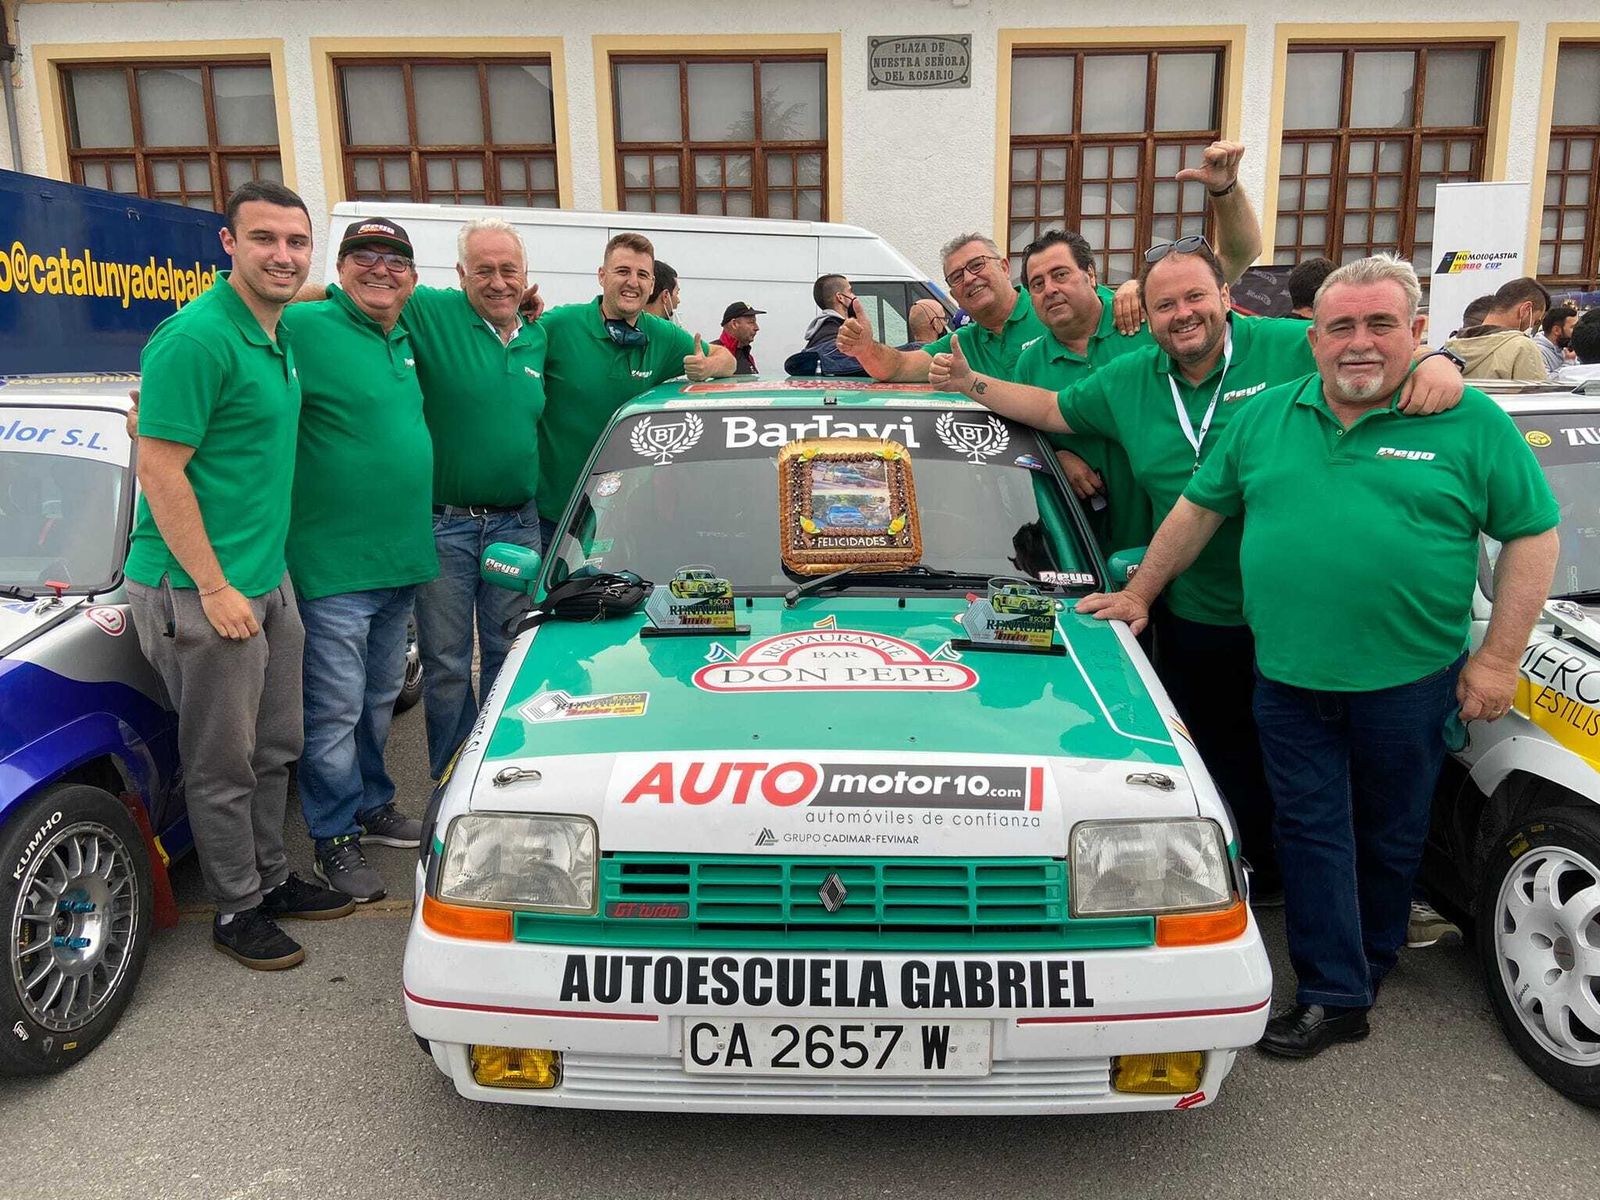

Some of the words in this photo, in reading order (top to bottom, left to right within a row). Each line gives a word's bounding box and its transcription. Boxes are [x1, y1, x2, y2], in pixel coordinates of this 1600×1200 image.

[895, 43, 927, 53] PLAZA
[931, 42, 945, 52] DE
[873, 57, 920, 68] NUESTRA
[925, 54, 966, 66] SEÑORA
[885, 71, 904, 81] DEL
[909, 70, 954, 80] ROSARIO
[1456, 252, 1518, 261] HOMOLOGASTUR
[1453, 262, 1482, 271] TURBO
[1485, 262, 1502, 270] CUP
[0, 420, 57, 442] lor
[61, 429, 108, 451] S.L.
[654, 427, 677, 444] BJ
[960, 426, 983, 444] BJ
[818, 536, 887, 548] FELICIDADES
[762, 634, 907, 658] RESTAURANTE
[812, 651, 859, 659] BAR
[721, 667, 827, 684] DON
[845, 667, 951, 683] PEPE
[805, 809, 914, 825] automóviles
[922, 811, 944, 826] de
[952, 812, 1041, 828] confianza
[13, 811, 62, 880] KUMHO
[783, 833, 821, 843] GRUPO
[823, 834, 919, 845] CADIMAR-FEVIMAR
[559, 954, 889, 1009] AUTOESCUELA
[900, 960, 1094, 1009] GABRIEL
[690, 1022, 752, 1067] CA
[770, 1024, 904, 1069] 2657
[921, 1025, 950, 1069] W
